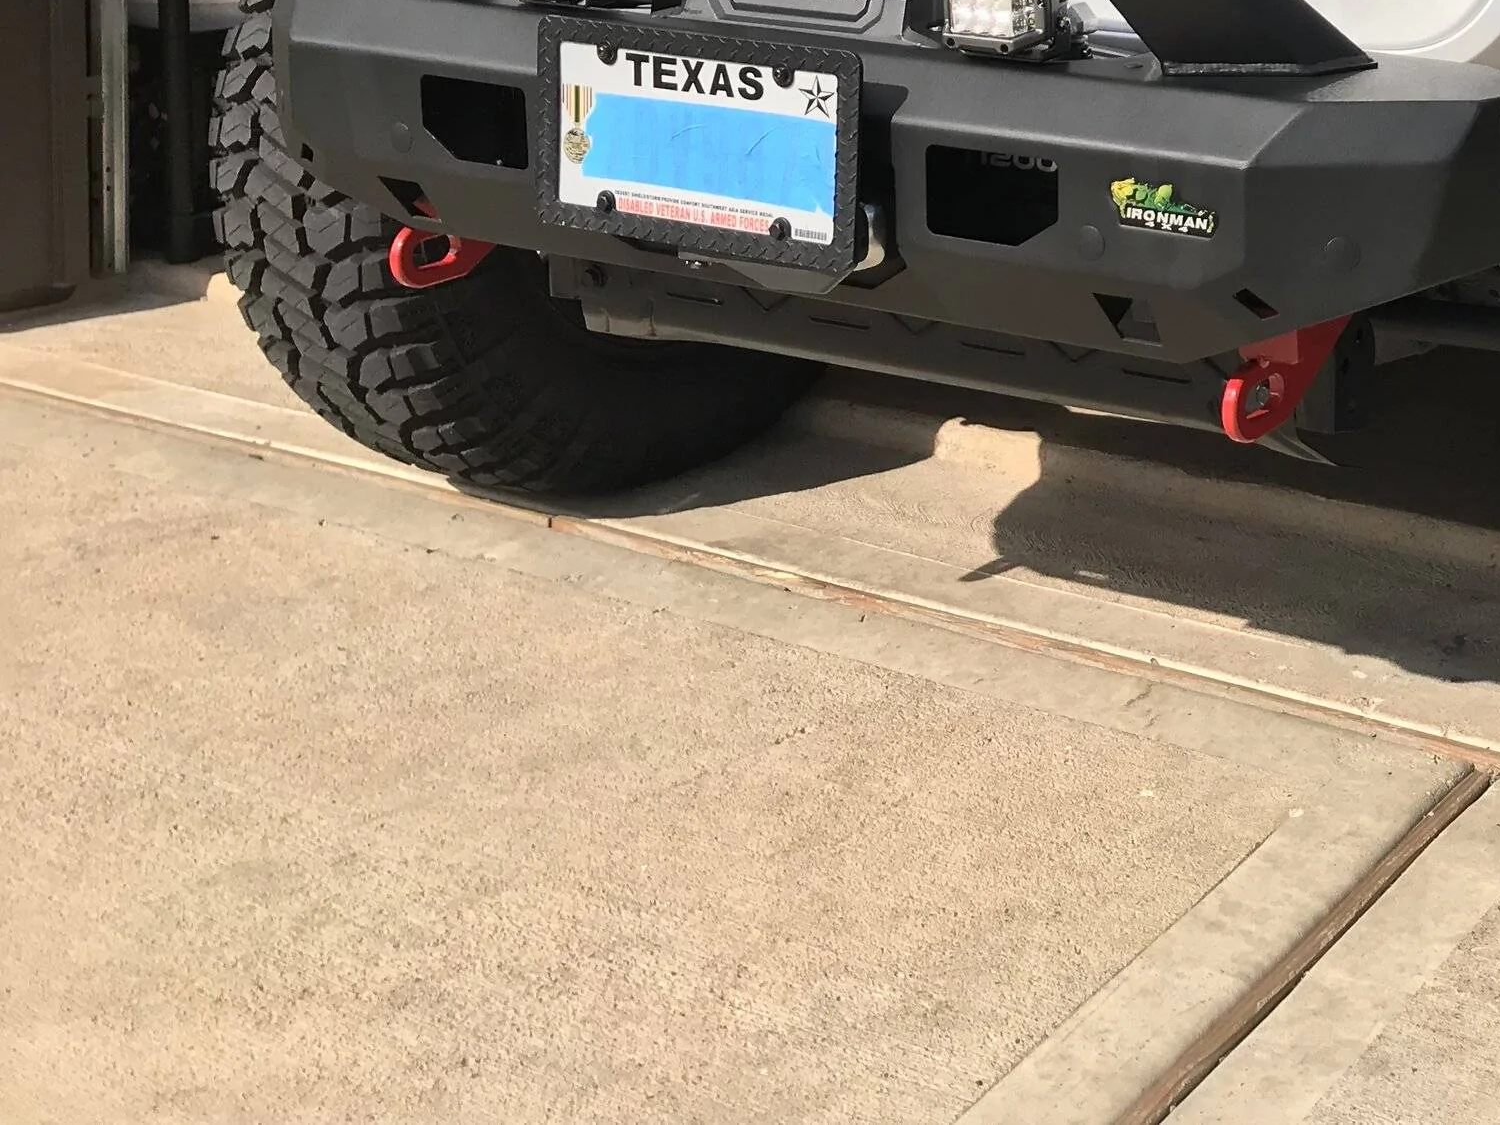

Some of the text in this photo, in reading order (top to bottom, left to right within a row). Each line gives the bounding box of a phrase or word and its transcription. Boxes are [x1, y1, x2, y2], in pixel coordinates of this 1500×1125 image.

[625, 52, 764, 101] TEXAS
[618, 197, 769, 233] DISABLED VETERAN U.S. ARMED FORCES
[1126, 206, 1209, 230] IRONMAN
